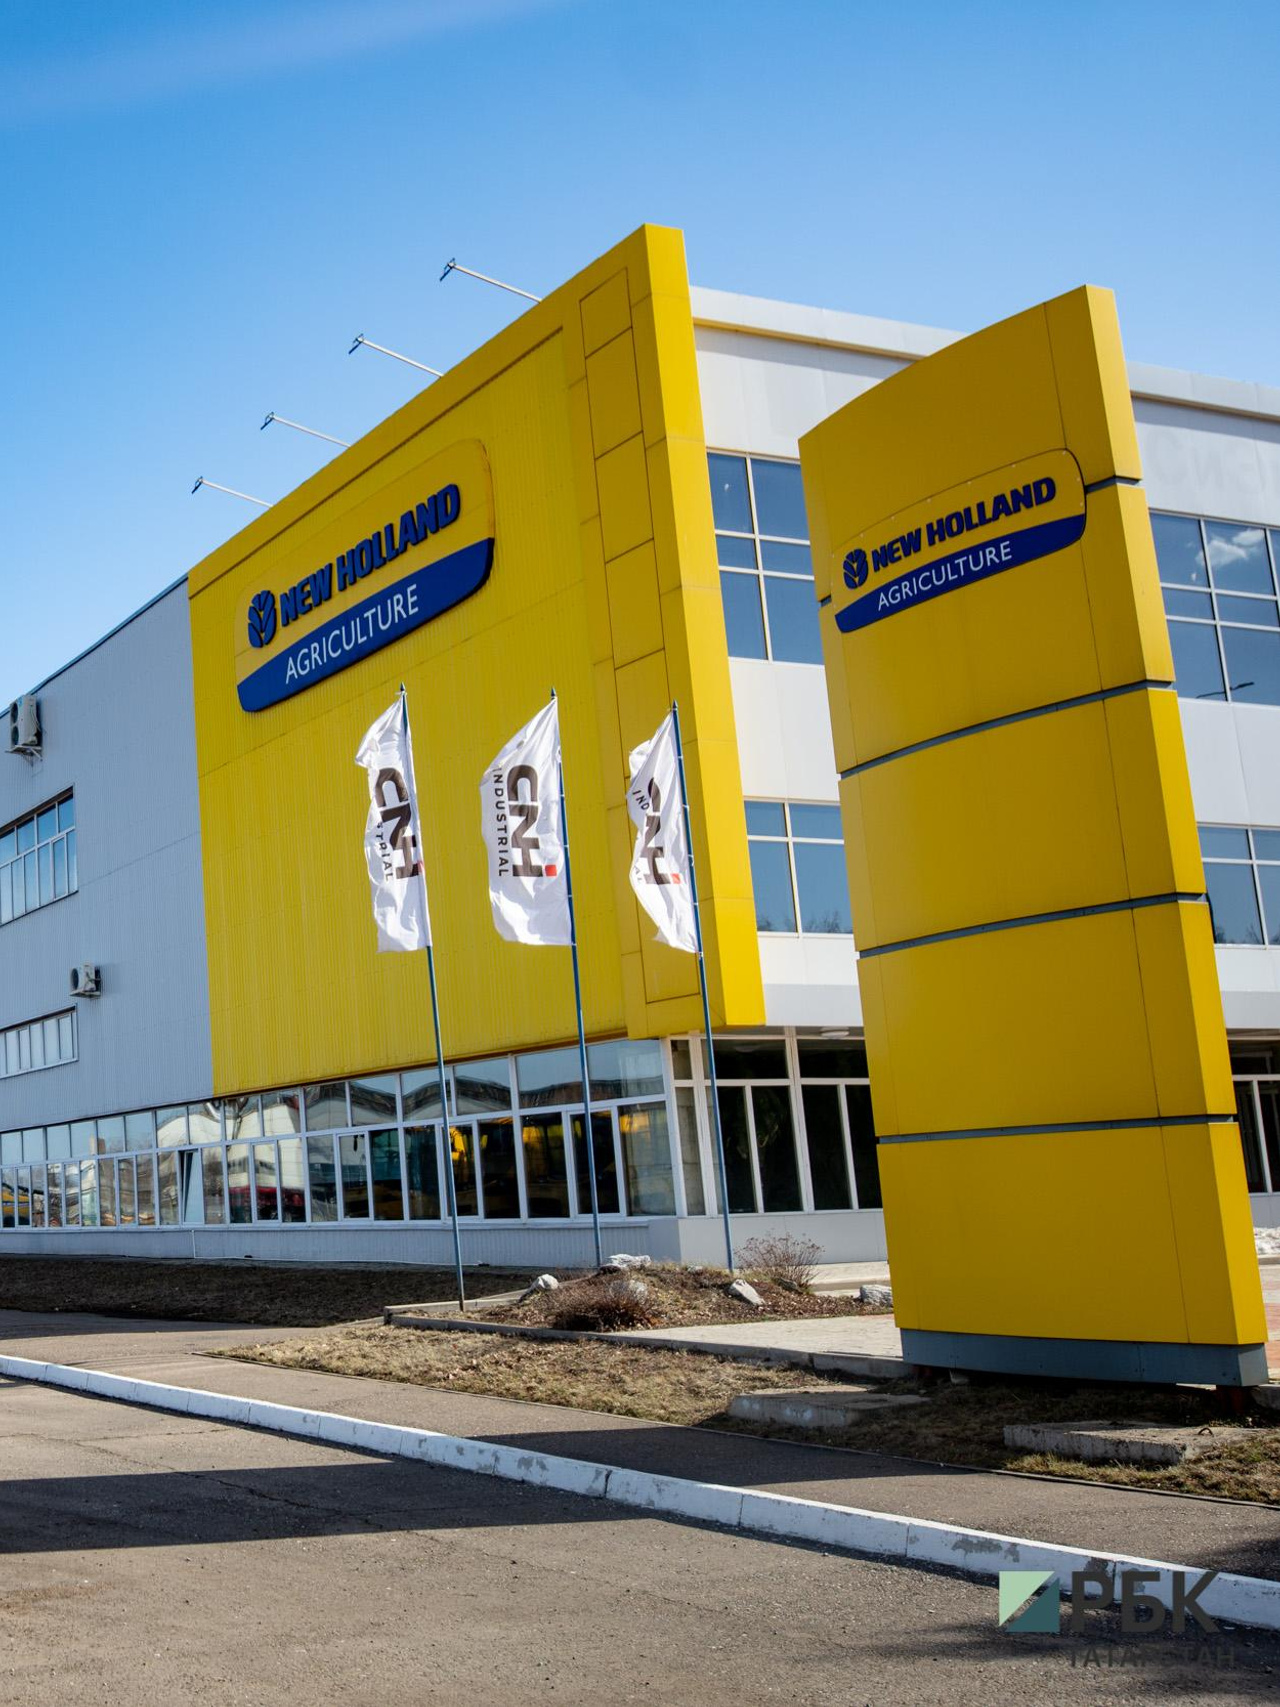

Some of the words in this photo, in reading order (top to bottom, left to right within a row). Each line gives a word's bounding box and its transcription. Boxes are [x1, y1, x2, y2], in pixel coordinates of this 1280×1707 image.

[280, 562, 333, 627] NEW
[336, 483, 461, 592] HOLLAND
[872, 528, 921, 572] NEW
[927, 477, 1056, 546] HOLLAND
[877, 541, 1013, 611] AGRICULTURE
[285, 584, 419, 684] AGRICULTURE
[492, 767, 509, 877] INDUSTRIAL
[507, 764, 544, 878] CNH
